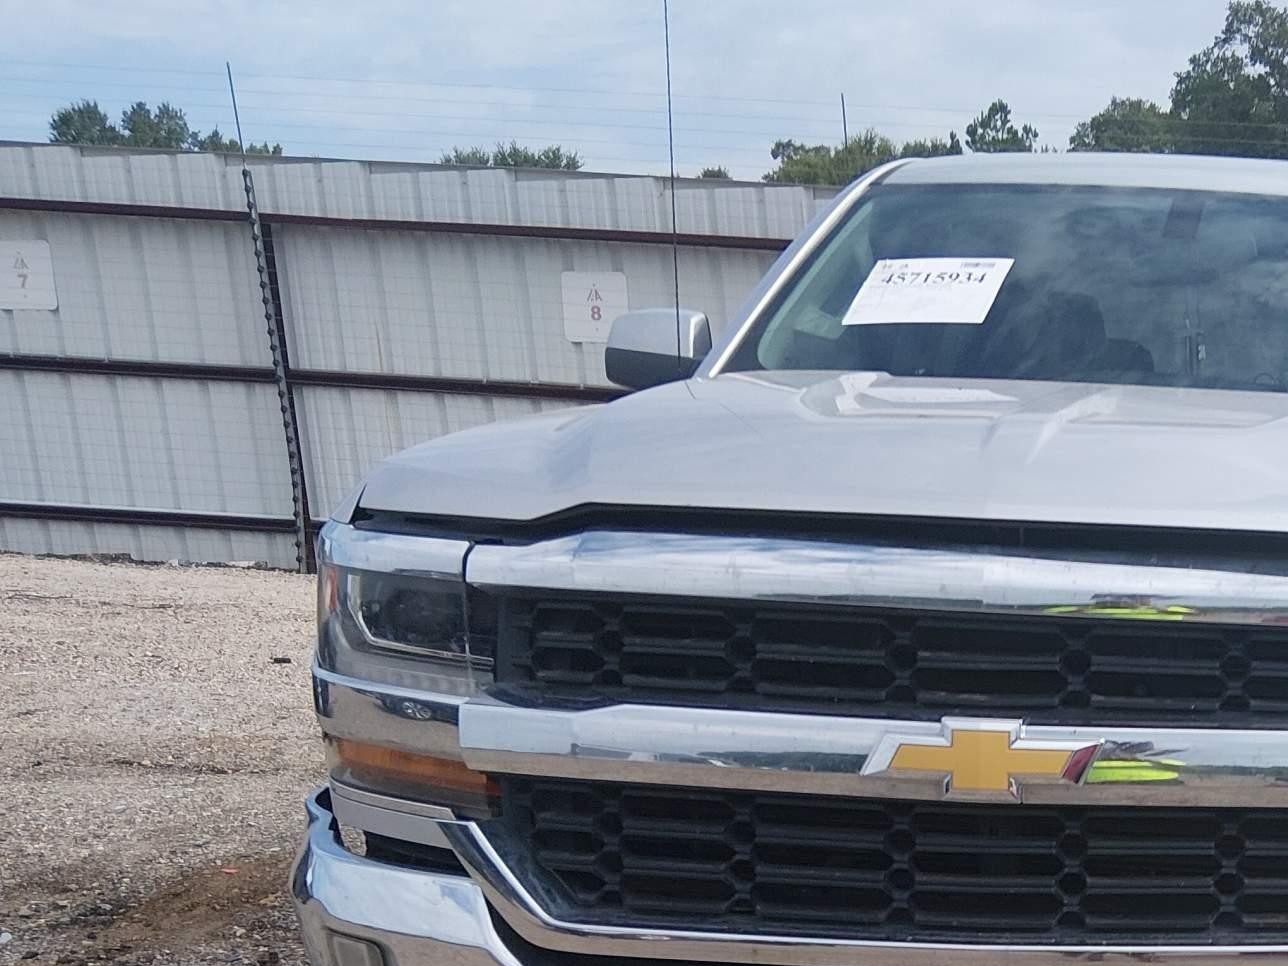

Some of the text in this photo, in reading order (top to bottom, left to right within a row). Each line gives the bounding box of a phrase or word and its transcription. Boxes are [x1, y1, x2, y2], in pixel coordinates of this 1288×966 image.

[17, 273, 28, 289] 7
[881, 272, 987, 285] 45715934
[591, 305, 602, 321] 8
